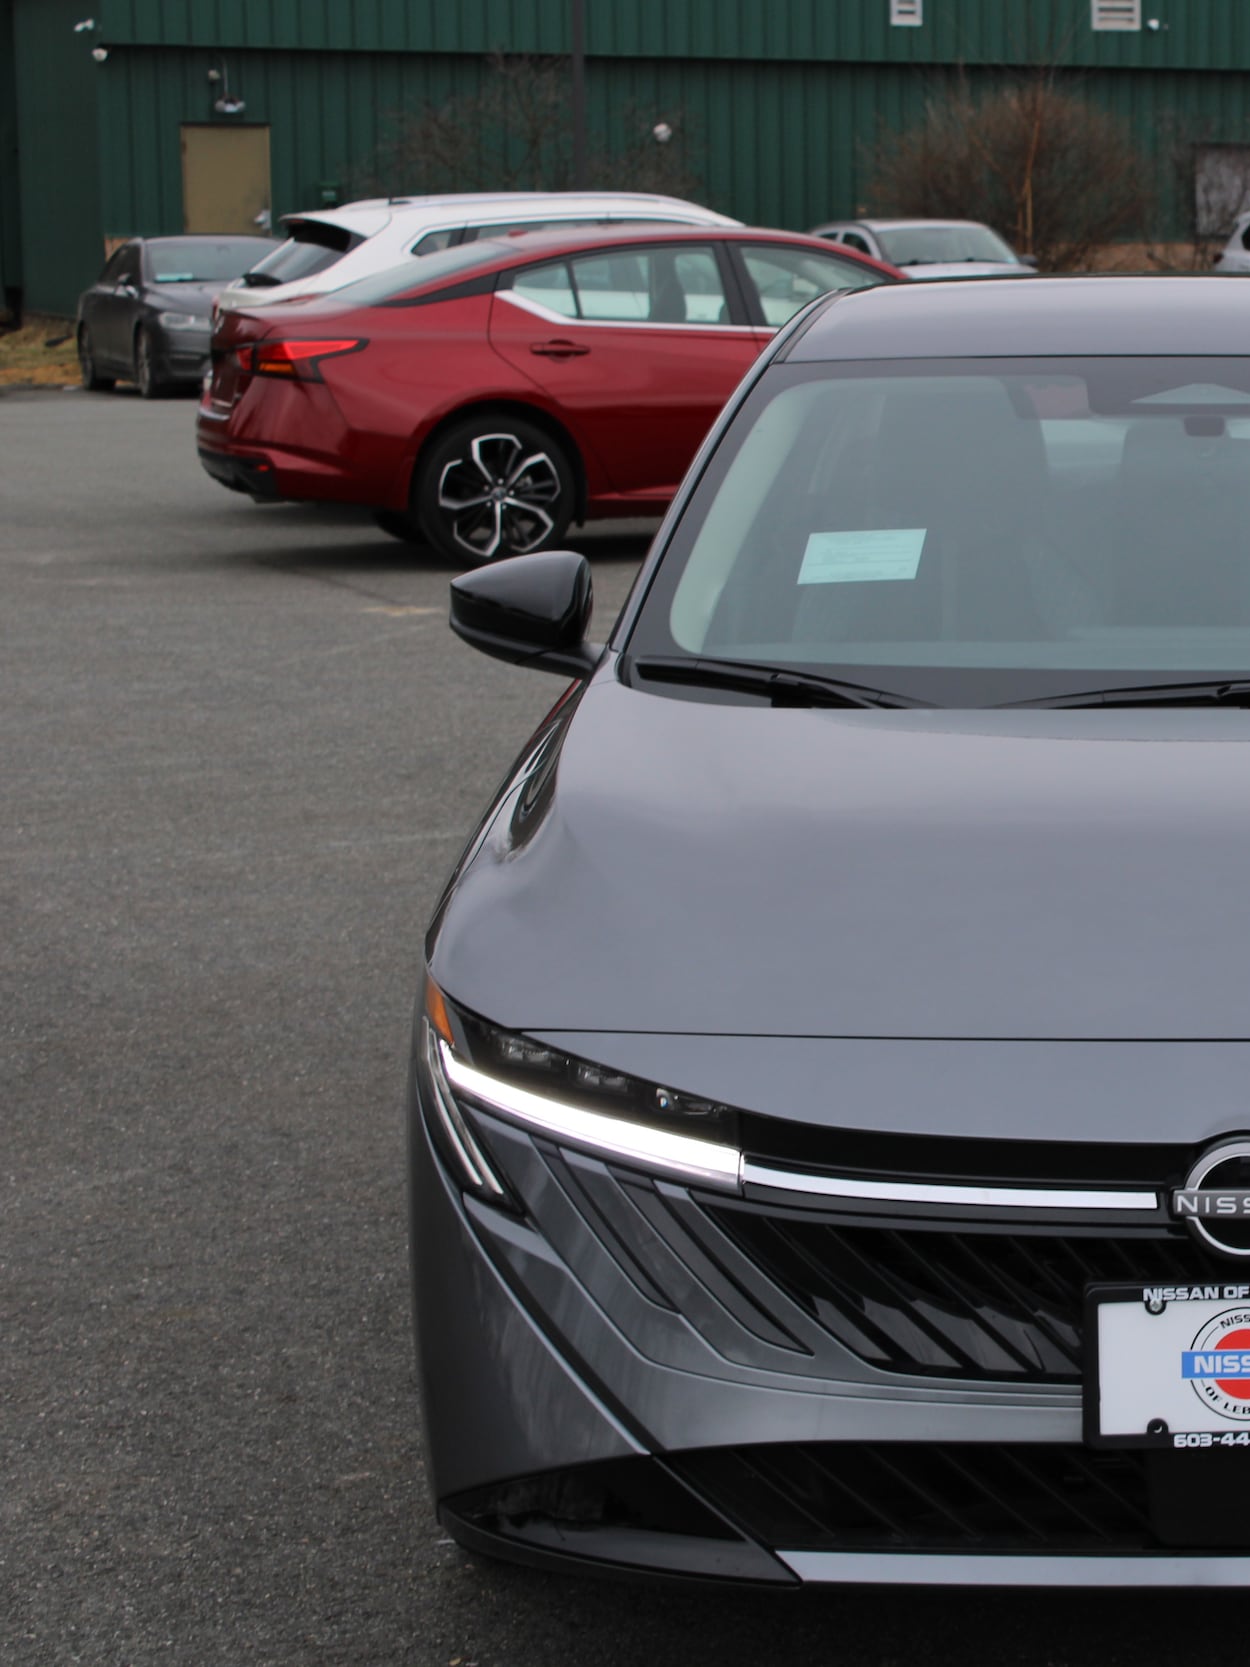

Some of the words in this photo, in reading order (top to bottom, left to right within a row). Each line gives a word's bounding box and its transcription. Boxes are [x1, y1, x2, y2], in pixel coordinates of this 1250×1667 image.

[1143, 1286, 1219, 1301] NISSAN
[1223, 1285, 1250, 1299] OF
[1205, 1386, 1222, 1401] OF
